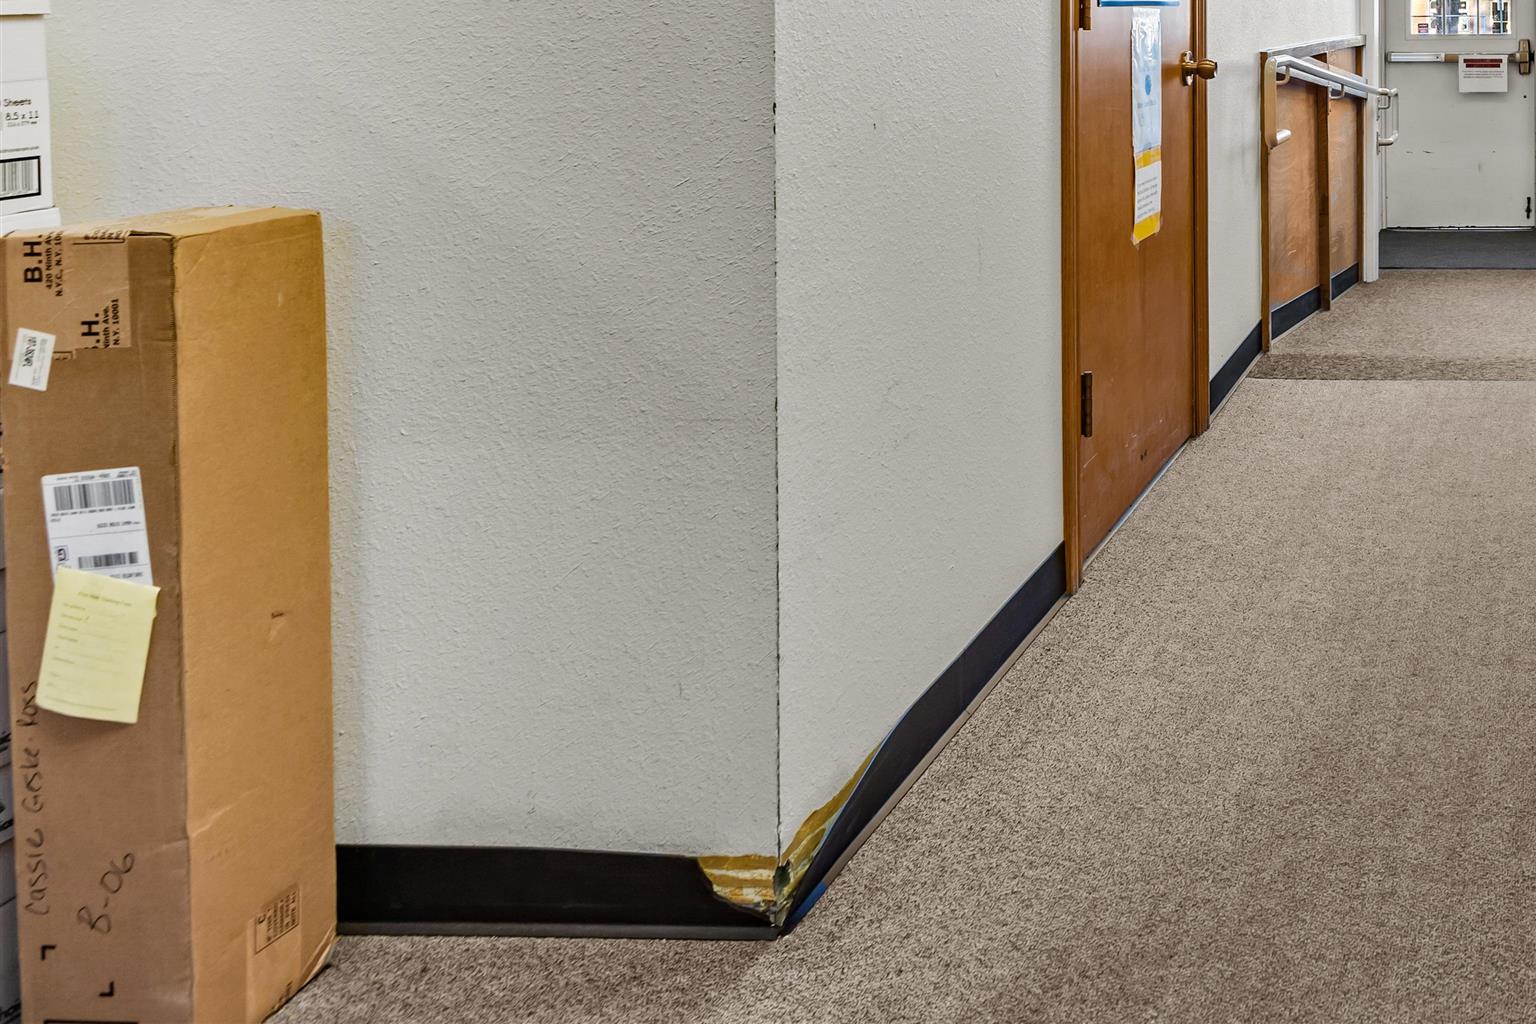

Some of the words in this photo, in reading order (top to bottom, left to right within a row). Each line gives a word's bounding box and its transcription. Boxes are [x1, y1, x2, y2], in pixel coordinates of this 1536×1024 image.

[3, 98, 31, 107] Sheets
[23, 234, 43, 283] B.H.
[45, 248, 53, 271] Ninth
[111, 298, 120, 325] 10001
[80, 312, 101, 350] .H.
[111, 328, 120, 346] N.Y.
